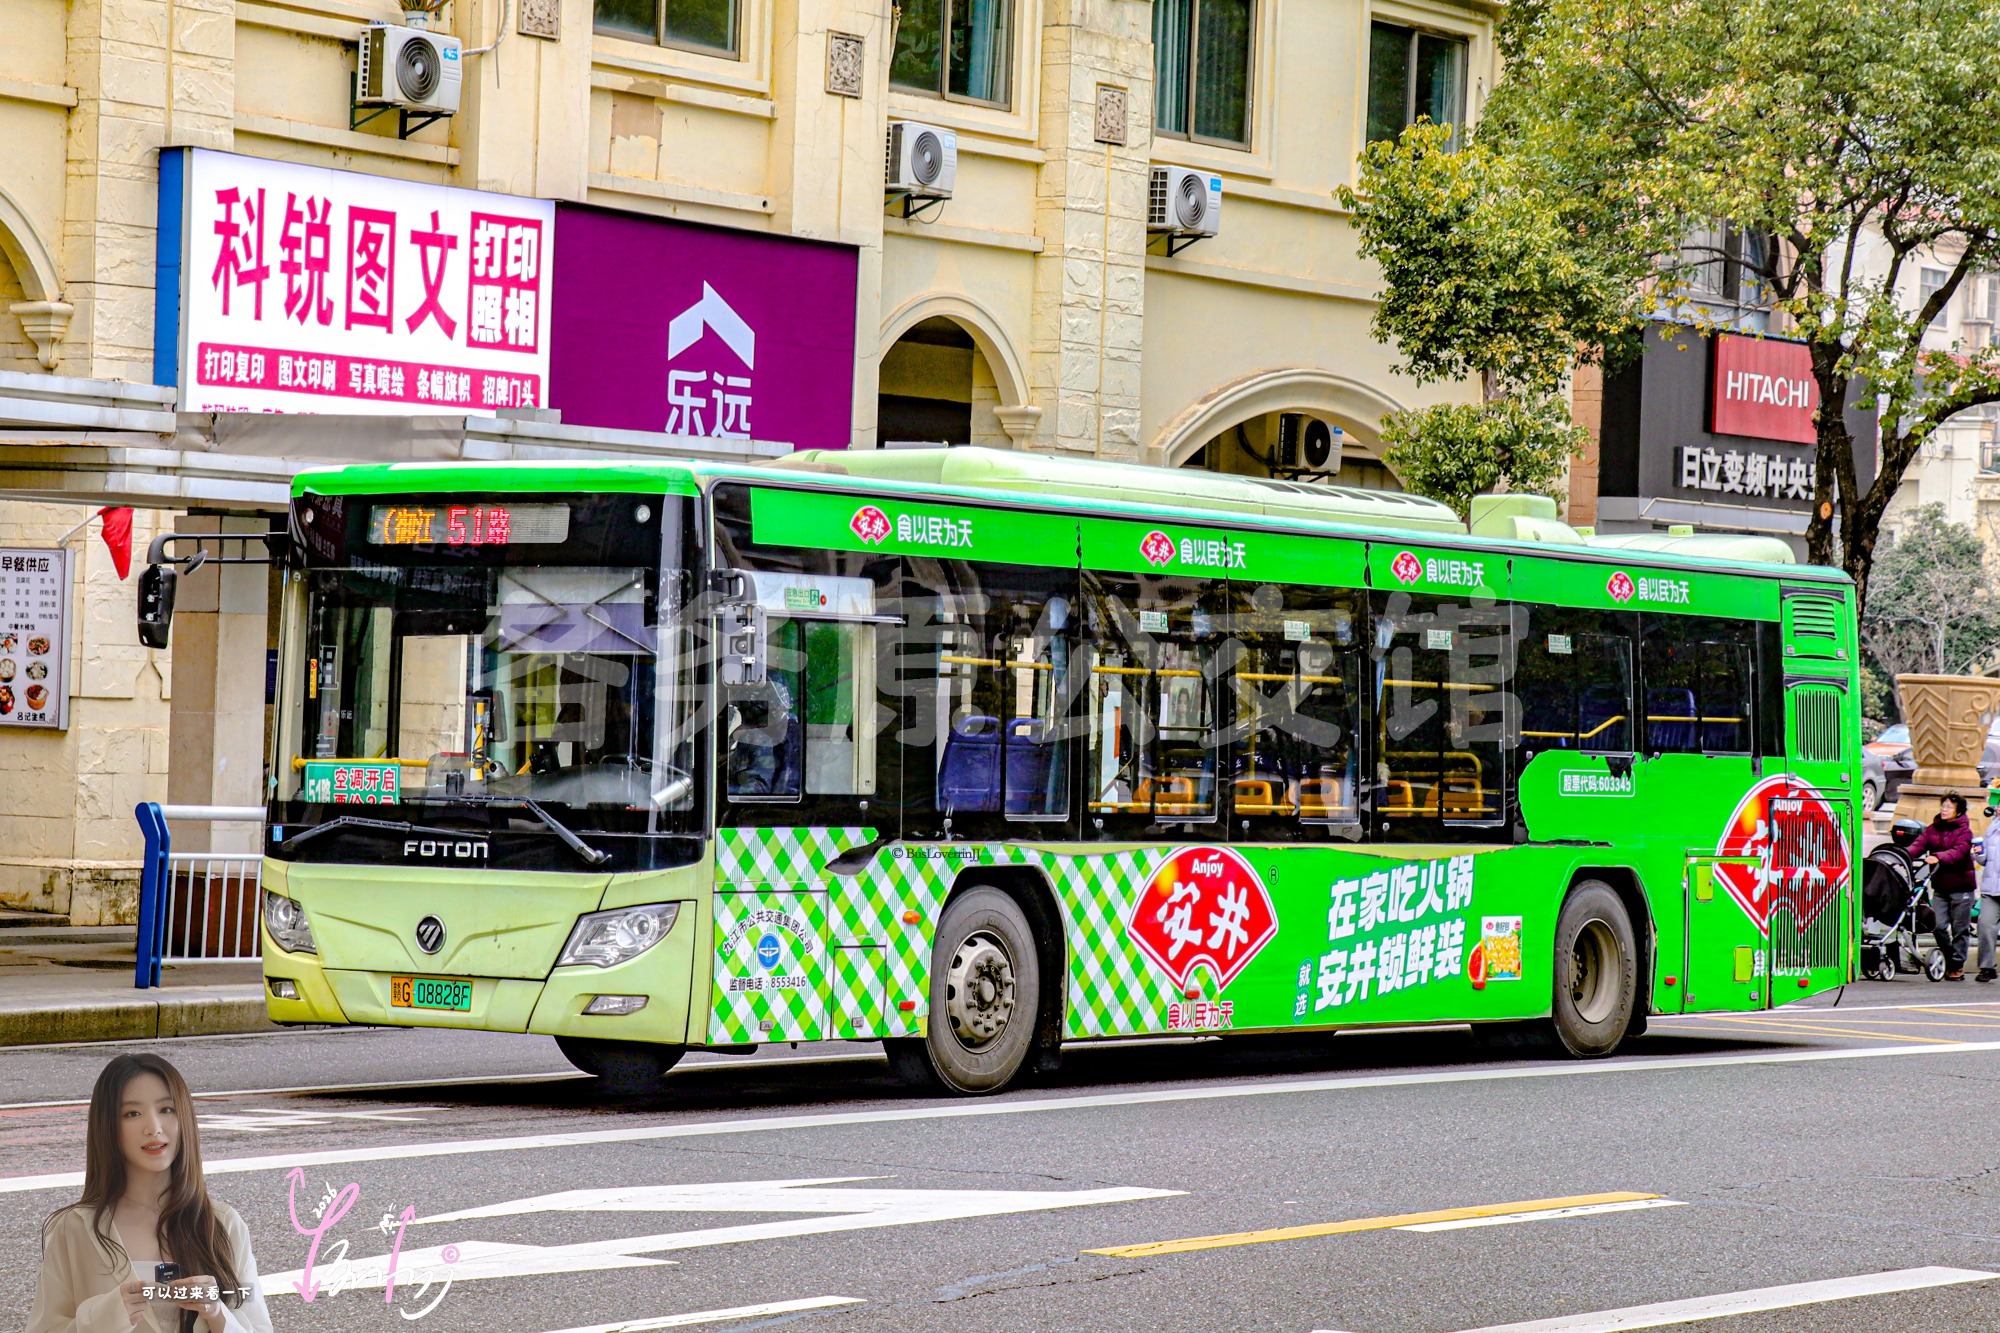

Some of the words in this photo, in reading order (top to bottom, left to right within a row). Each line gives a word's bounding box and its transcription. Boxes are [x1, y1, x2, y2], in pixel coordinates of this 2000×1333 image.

[211, 186, 458, 341] 科锐图文
[473, 219, 538, 282] 打印
[471, 284, 536, 347] 照相
[204, 348, 265, 384] 打印复印
[278, 355, 336, 391] 图文印刷
[349, 363, 405, 398] 写真喷绘
[417, 368, 471, 403] 条幅旗帜
[482, 375, 534, 408] 招牌门头
[1726, 370, 1809, 408] HITACHI
[665, 370, 752, 440] 乐远
[1682, 445, 1839, 502] 日立变频中央
[897, 514, 973, 547] 食以民为天
[2, 556, 49, 572] 早餐供应
[1180, 538, 1246, 569] 食以民为天
[1426, 558, 1484, 587] 食以民为天
[1638, 577, 1690, 604] 食以民为天
[334, 767, 395, 791] 空调开启
[404, 840, 488, 858] FOTON
[1191, 855, 1224, 878] Anjoy
[1328, 854, 1475, 941] 在家吃火锅
[723, 910, 814, 955] 九江市公共交通集团公司
[1157, 881, 1250, 961] 安井
[1314, 917, 1466, 1012] 安井锁鲜装
[1294, 963, 1312, 1017] 就选
[1168, 1001, 1233, 1029] 食以民为天
